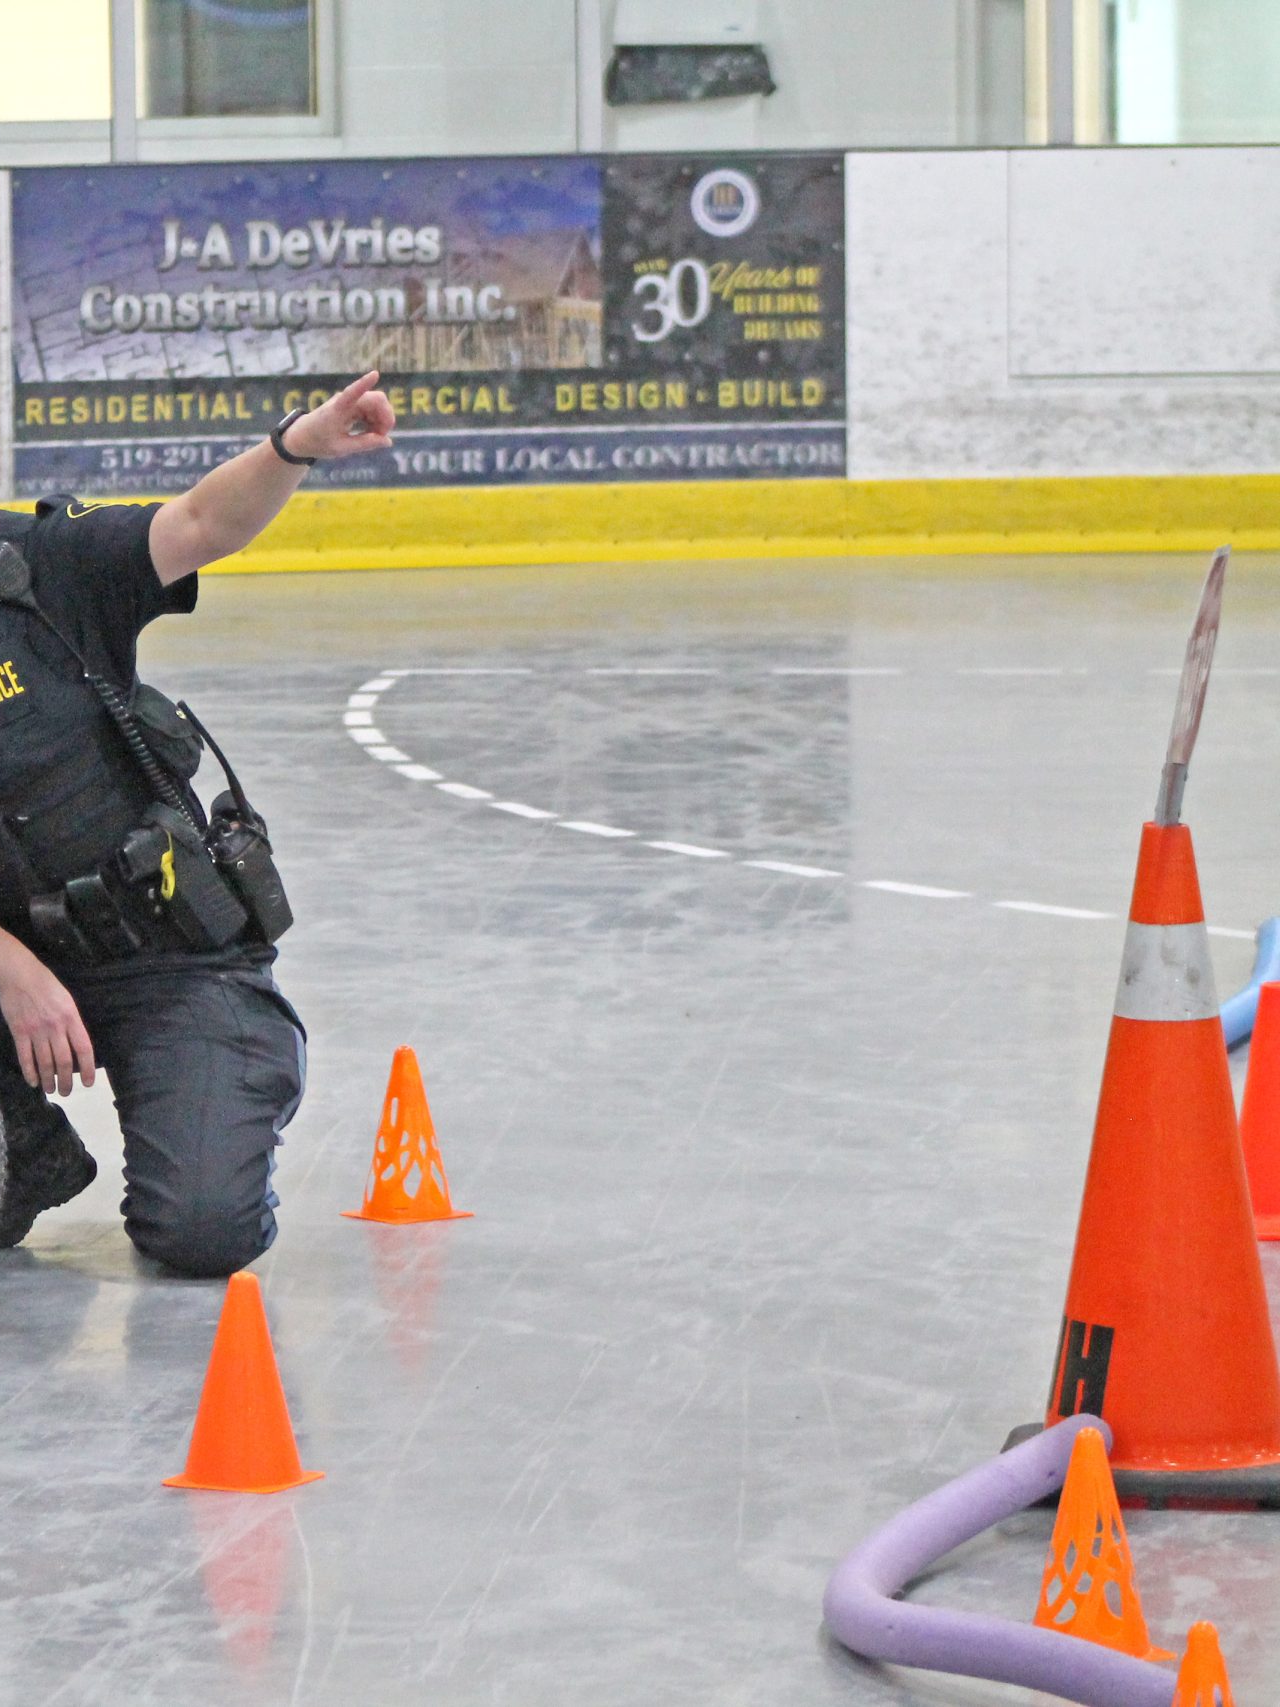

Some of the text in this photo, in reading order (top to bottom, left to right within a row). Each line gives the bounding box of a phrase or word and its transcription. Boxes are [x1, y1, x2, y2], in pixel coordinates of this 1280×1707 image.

[245, 217, 442, 270] DeVries
[79, 277, 518, 334] Construction Inc.
[630, 257, 711, 342] 30
[25, 383, 517, 426] RESIDENTIAL COERCIAL
[555, 379, 824, 412] DESIGN BUILD
[393, 441, 842, 474] YOUR LOCAL CONTRACTOR
